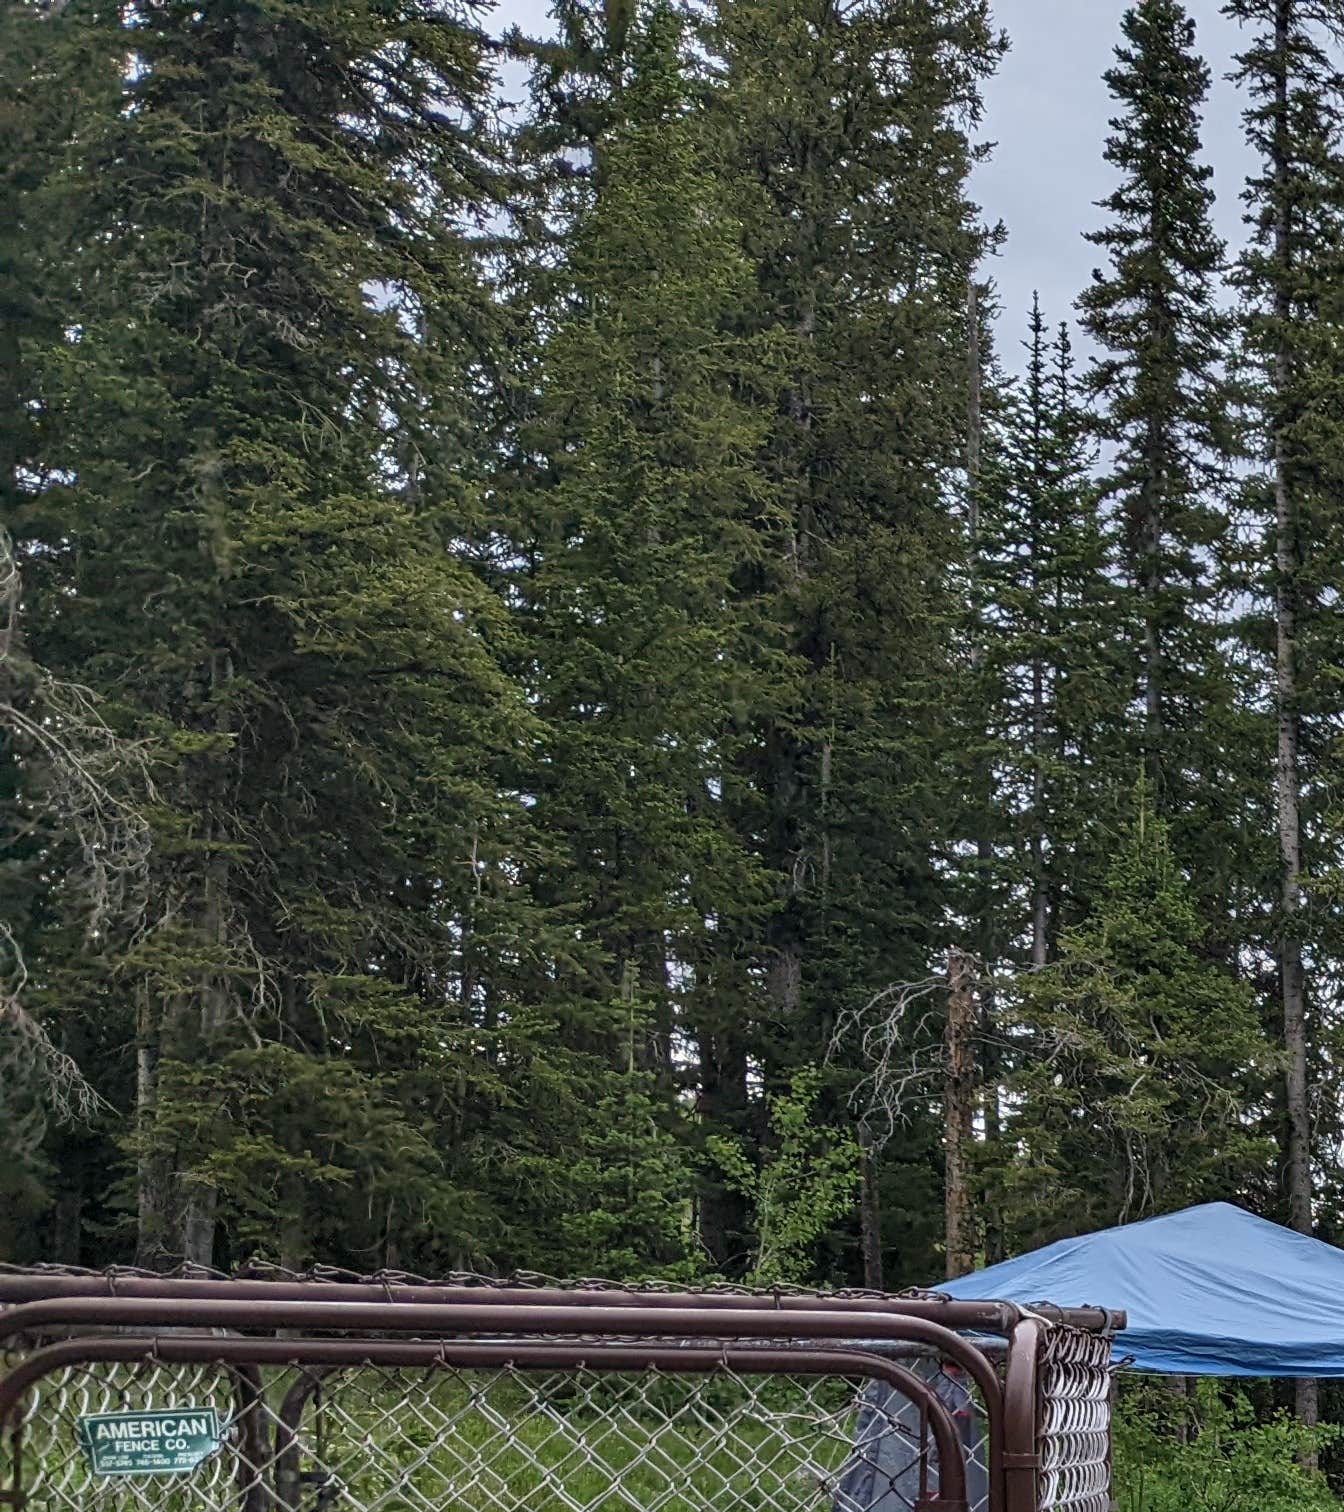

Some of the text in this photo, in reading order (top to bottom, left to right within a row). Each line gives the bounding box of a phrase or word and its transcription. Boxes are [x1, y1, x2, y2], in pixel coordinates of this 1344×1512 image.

[97, 1418, 208, 1440] AMERICAN
[115, 1438, 190, 1452] FENCE CO.
